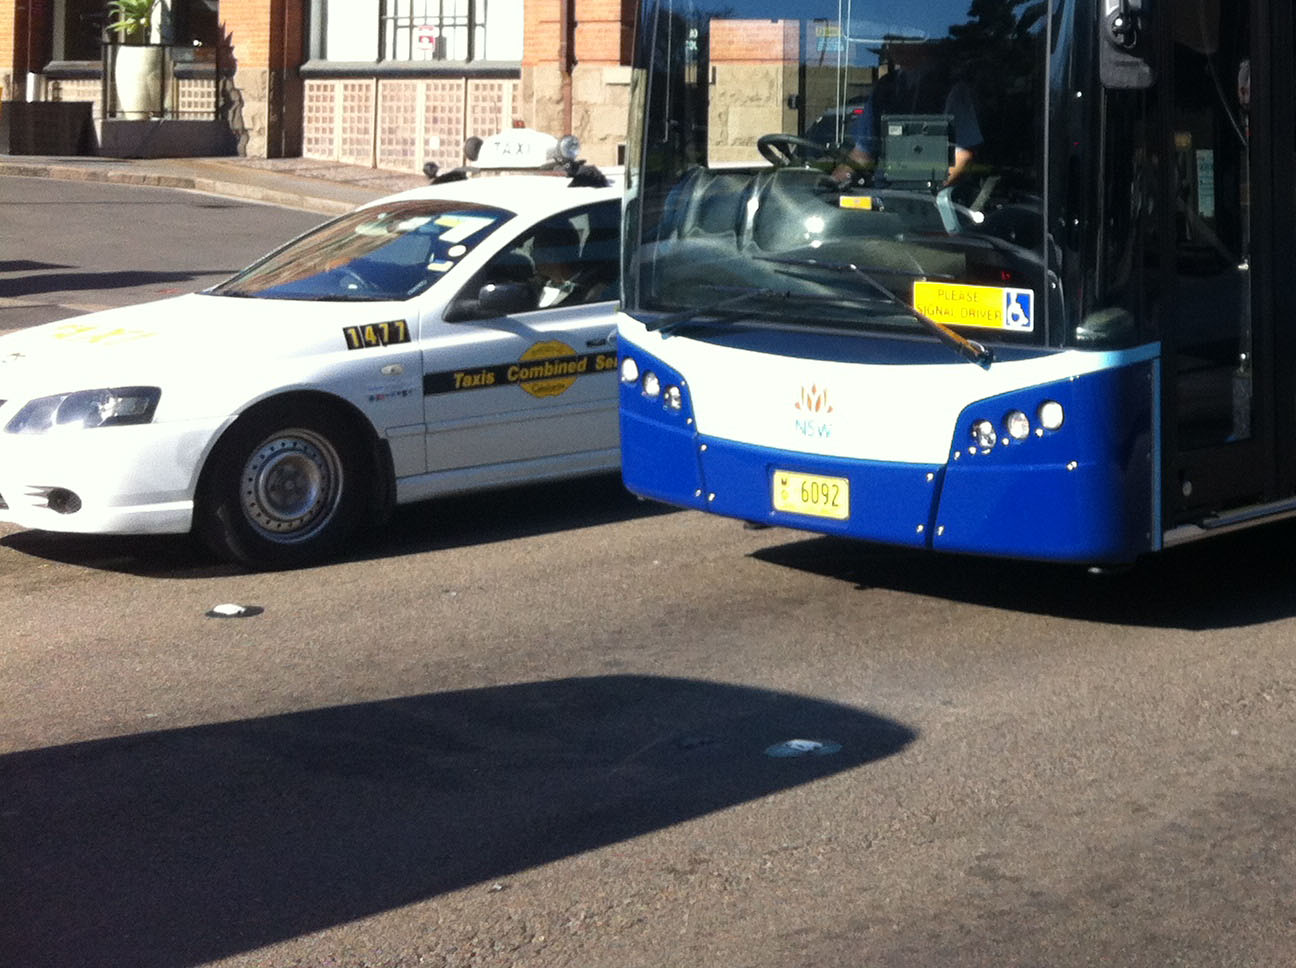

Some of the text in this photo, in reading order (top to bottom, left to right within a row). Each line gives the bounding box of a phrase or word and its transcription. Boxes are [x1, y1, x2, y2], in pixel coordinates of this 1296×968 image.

[937, 288, 979, 303] PLEASE
[917, 303, 1002, 322] SIGNAL DRIVER
[346, 320, 405, 348] 1477
[453, 370, 496, 389] Taxis
[506, 357, 588, 382] Combined
[795, 418, 833, 439] NSW
[801, 480, 840, 507] 6092
